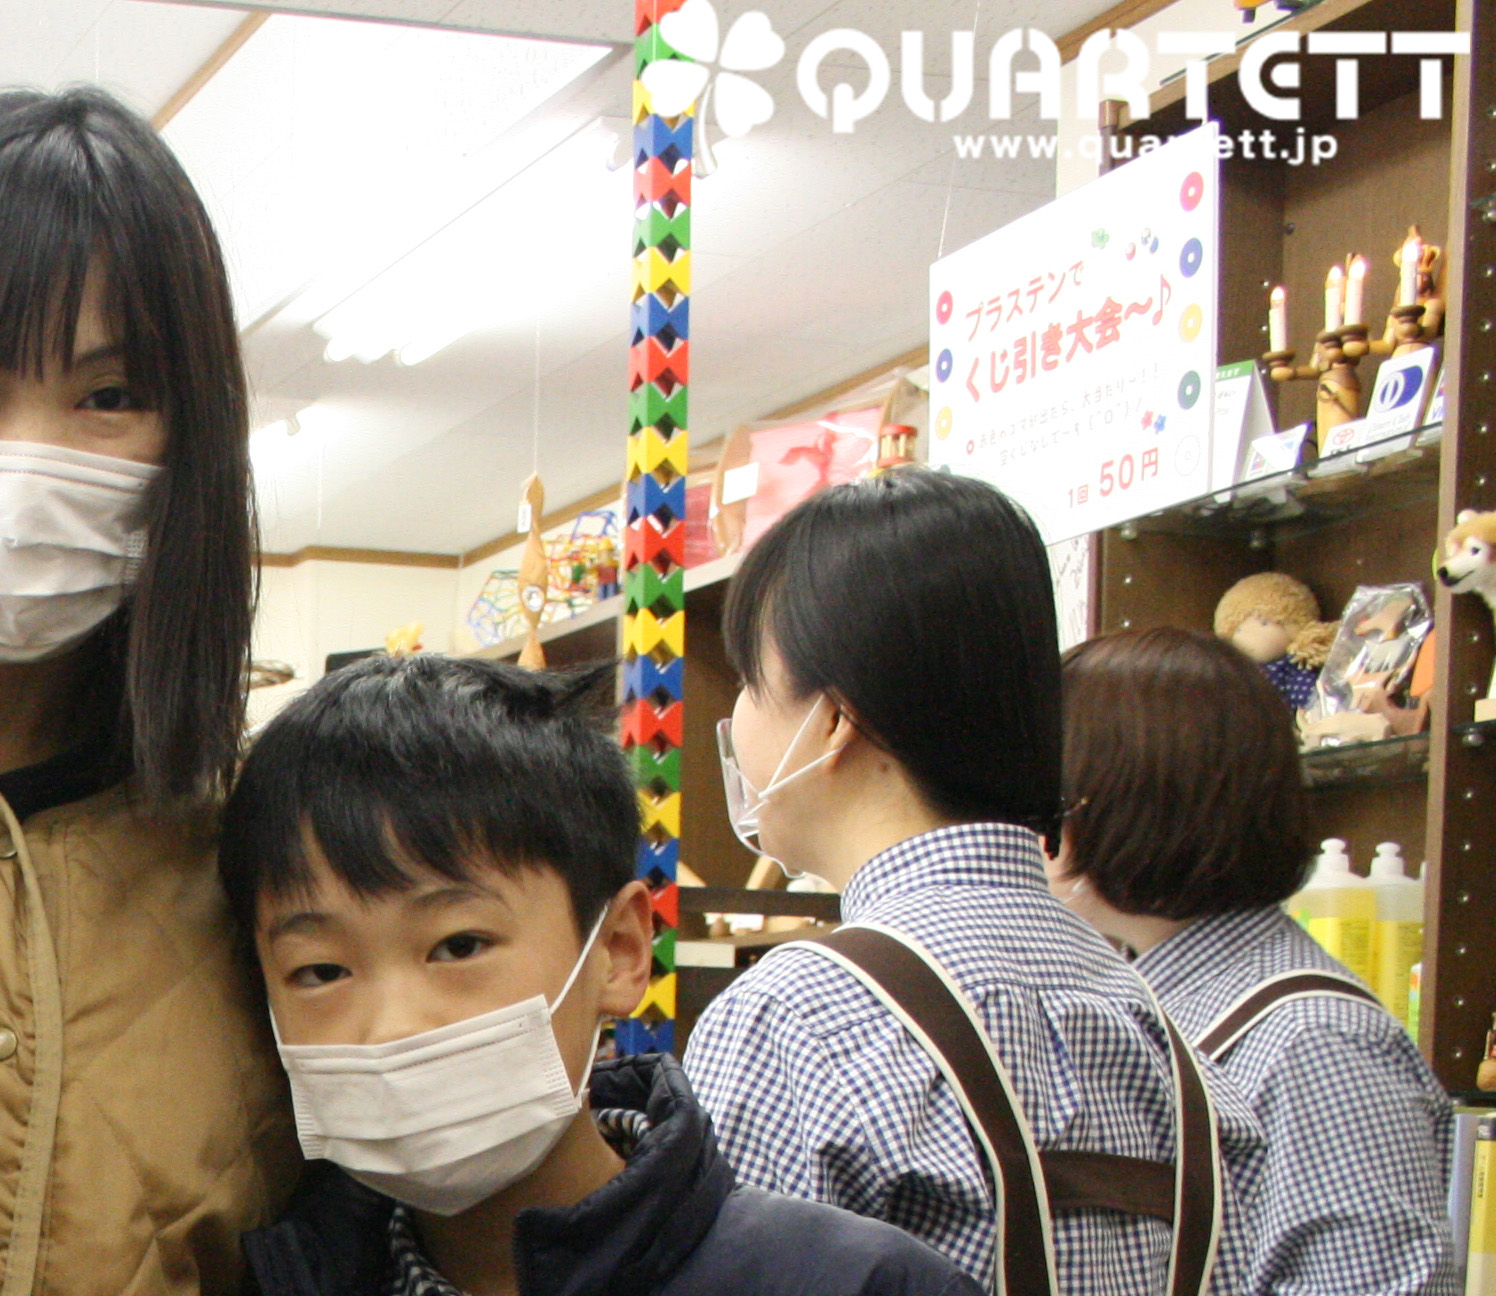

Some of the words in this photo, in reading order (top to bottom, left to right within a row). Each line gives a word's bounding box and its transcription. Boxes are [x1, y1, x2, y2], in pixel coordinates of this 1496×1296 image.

[965, 260, 1084, 342] プラステンで
[1099, 446, 1159, 498] 50円
